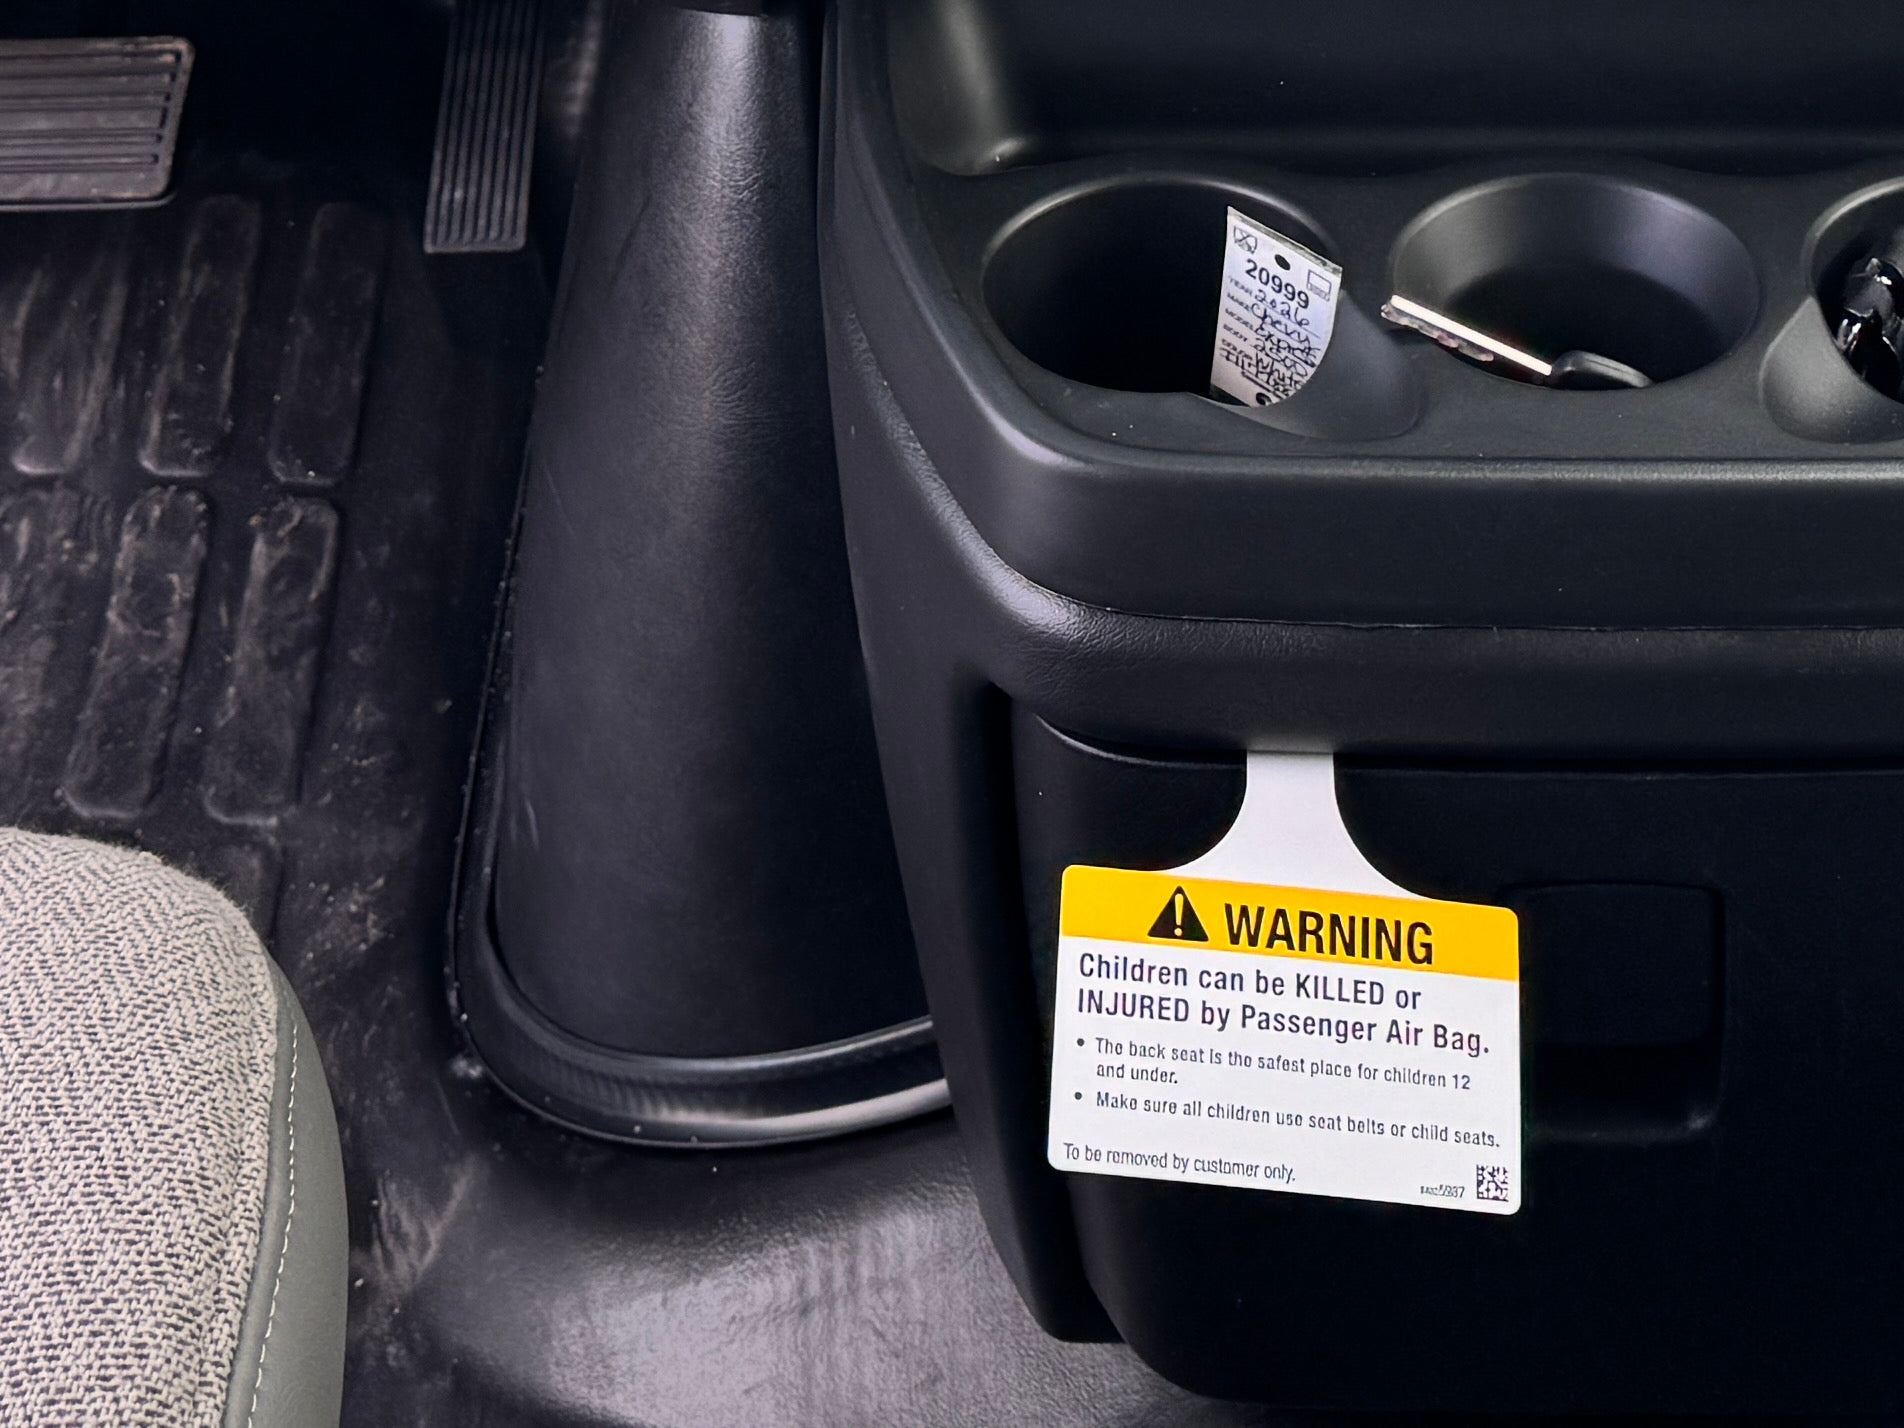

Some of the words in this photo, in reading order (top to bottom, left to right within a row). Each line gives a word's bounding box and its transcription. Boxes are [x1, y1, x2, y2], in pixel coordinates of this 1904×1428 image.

[1245, 257, 1309, 309] 20999
[1254, 288, 1310, 326] 2026
[1224, 903, 1433, 965] WARNING
[1079, 952, 1188, 987] Children
[1198, 969, 1244, 992] can
[1256, 969, 1285, 995] be
[1296, 973, 1384, 1006] KILLED
[1395, 990, 1422, 1010] or
[1078, 988, 1189, 1022] INJURED
[1201, 1000, 1230, 1032] by
[1241, 1004, 1377, 1043] Passenger
[1386, 1019, 1423, 1046] Air
[1433, 1024, 1489, 1058] Bag.
[1095, 1037, 1123, 1055] The
[1129, 1040, 1166, 1059] back
[1171, 1047, 1205, 1063] seat
[1210, 1049, 1222, 1064] is
[1228, 1051, 1251, 1068] the
[1258, 1054, 1305, 1073] safest
[1310, 1059, 1351, 1078] place
[1357, 1063, 1379, 1081] for
[1384, 1067, 1446, 1088] children
[1452, 1074, 1471, 1090] 12
[1096, 1063, 1124, 1079] and
[1130, 1066, 1178, 1085] under.
[1096, 1091, 1137, 1110] Make
[1143, 1098, 1177, 1115] sure
[1183, 1100, 1202, 1116] all
[1207, 1102, 1270, 1124] children
[1276, 1112, 1303, 1126] use
[1308, 1114, 1342, 1131] seat
[1347, 1116, 1385, 1135] belts
[1390, 1123, 1406, 1137] or
[1411, 1124, 1448, 1142] child
[1454, 1129, 1500, 1148] seats.
[1063, 1142, 1080, 1161] To
[1084, 1144, 1102, 1162] be
[1106, 1148, 1168, 1169] removed
[1172, 1153, 1189, 1174] by
[1194, 1157, 1260, 1178] customer
[1264, 1163, 1296, 1184] only.
